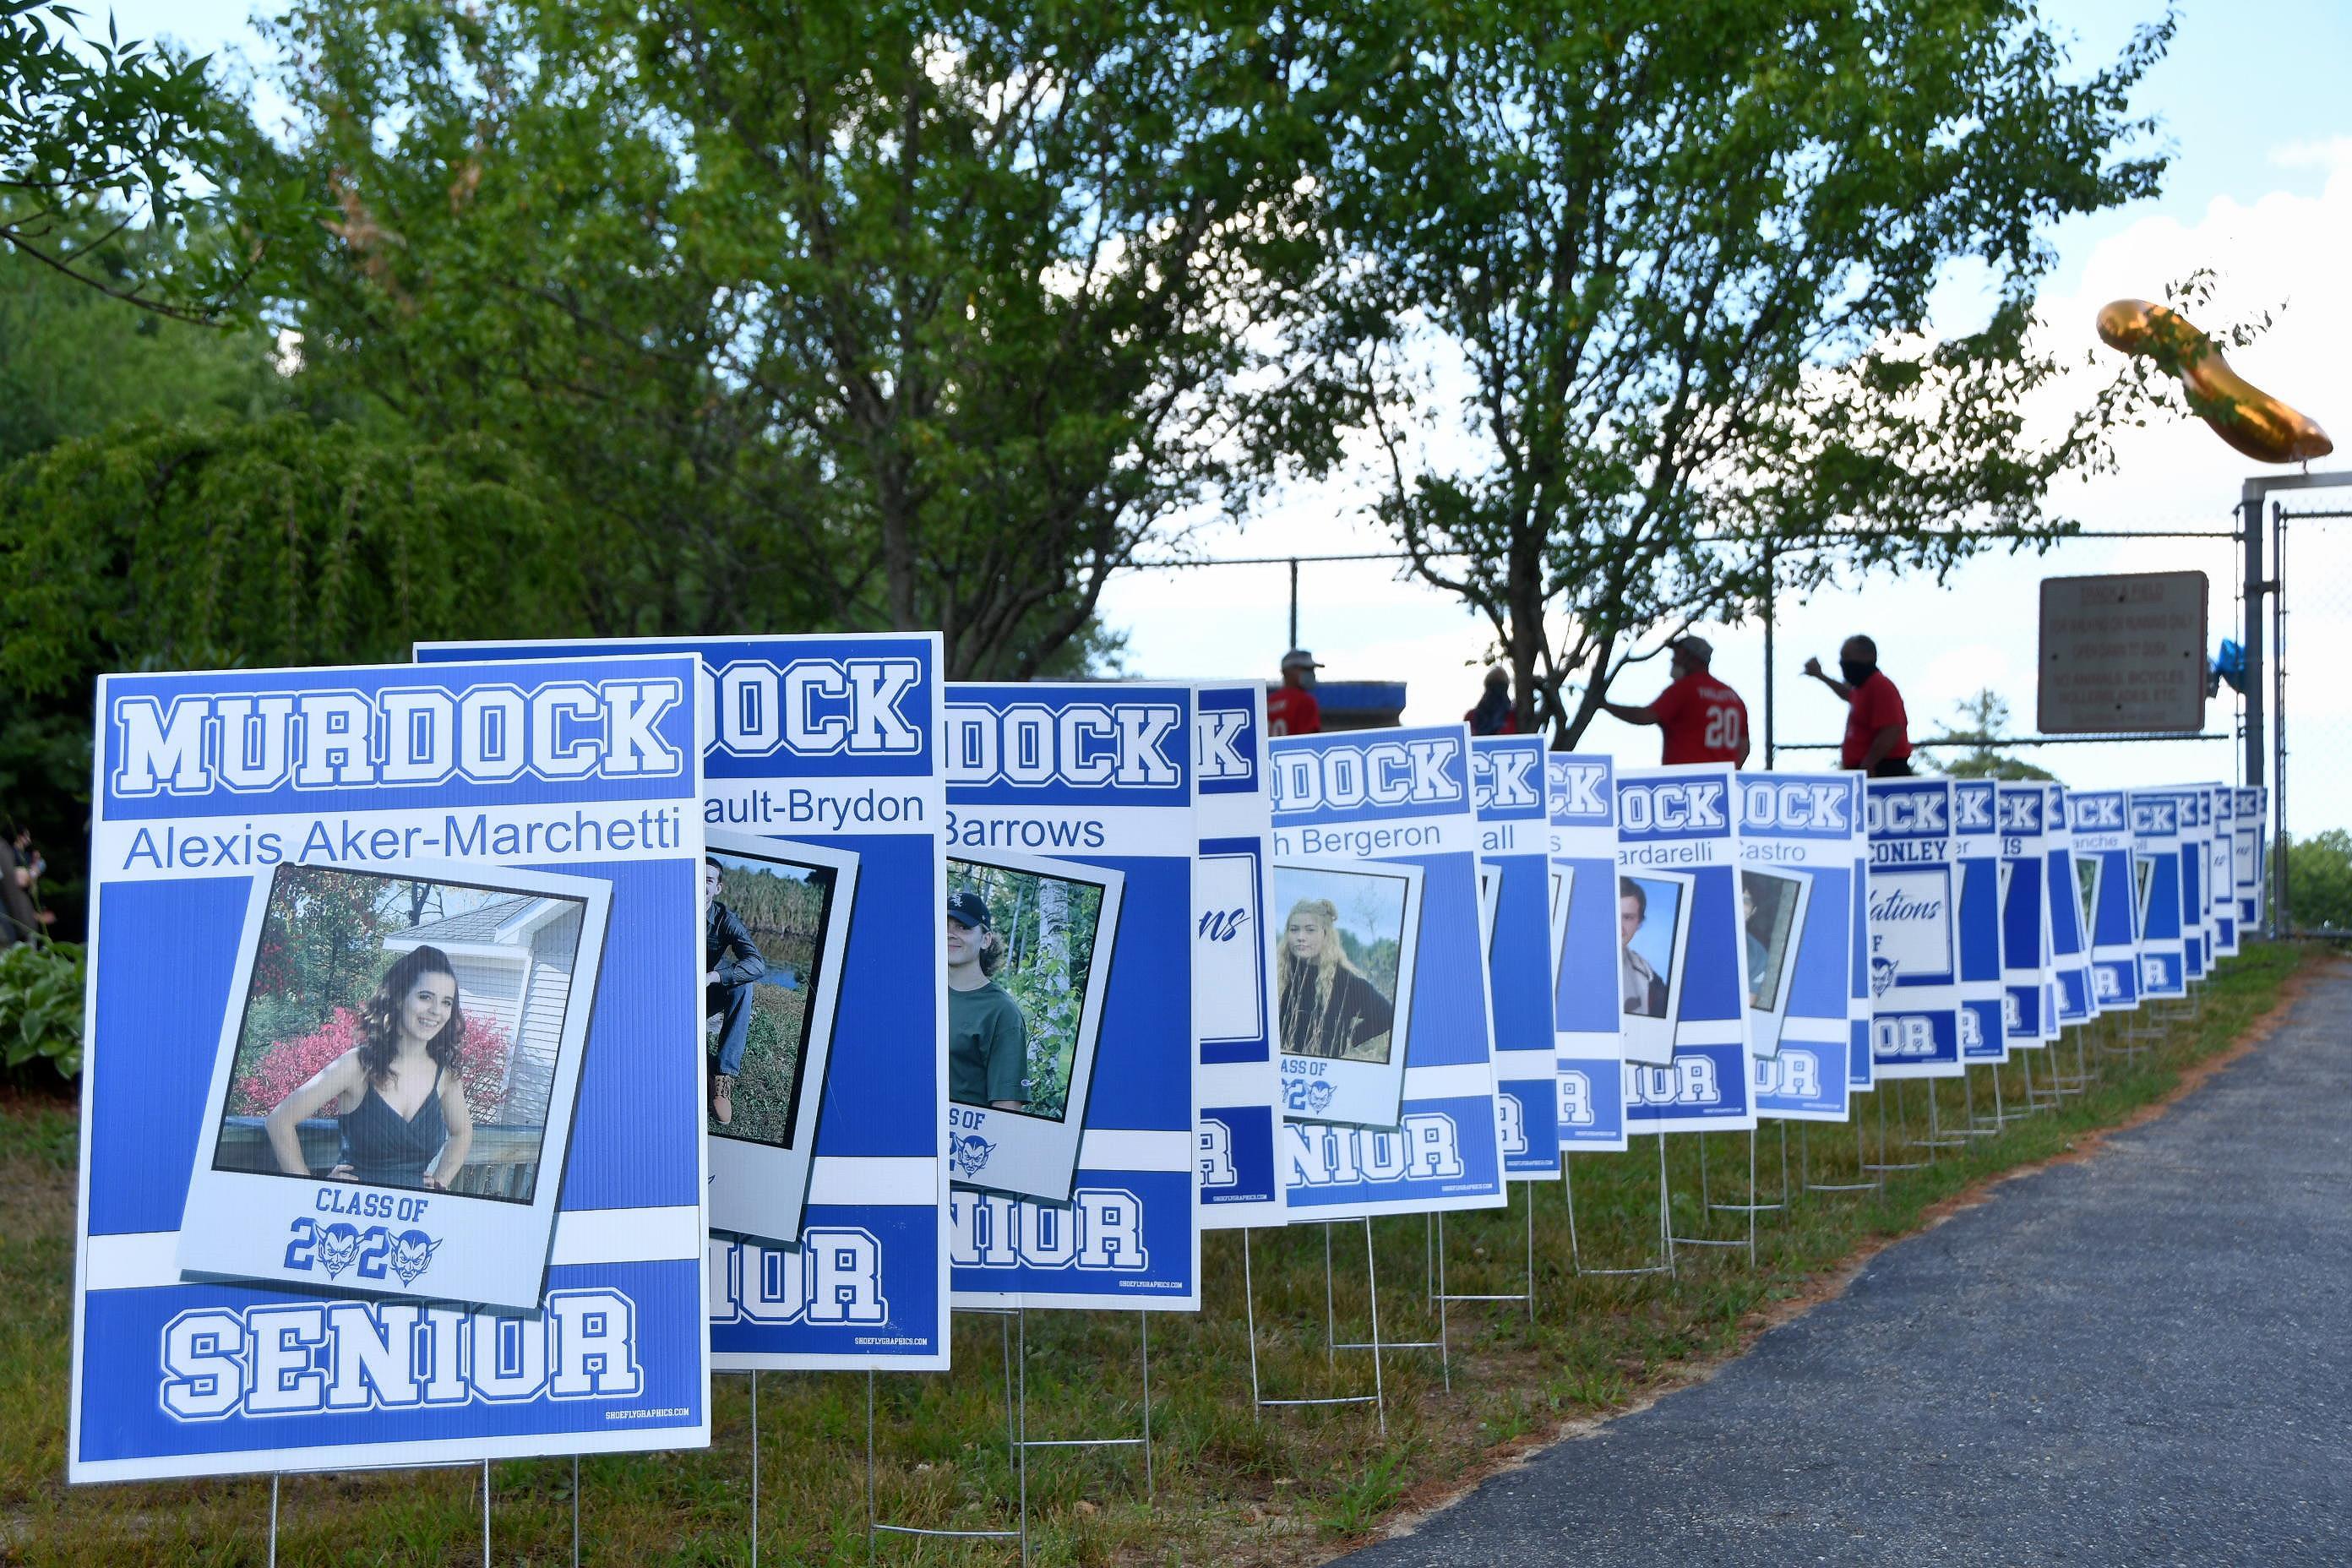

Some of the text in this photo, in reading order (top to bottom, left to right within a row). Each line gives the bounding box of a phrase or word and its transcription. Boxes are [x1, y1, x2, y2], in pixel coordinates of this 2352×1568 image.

[112, 678, 683, 798] MURDOCK
[1704, 705, 1740, 749] 20
[1269, 738, 1462, 813] DOCK
[704, 787, 924, 831] ault-Brydon
[122, 806, 681, 871] Alexis Aker-Marchetti
[1302, 825, 1440, 858] Bergeron
[1740, 840, 1805, 862] astro
[1309, 1061, 1328, 1076] OF
[961, 1110, 986, 1130] OF
[315, 1187, 429, 1222] CLASS OF
[159, 1287, 644, 1423] SENIOR
[854, 1337, 928, 1346] SHOEFLYGRAPHICS.COM
[605, 1407, 690, 1420] SHOEFLYGRAPHICS.COM
